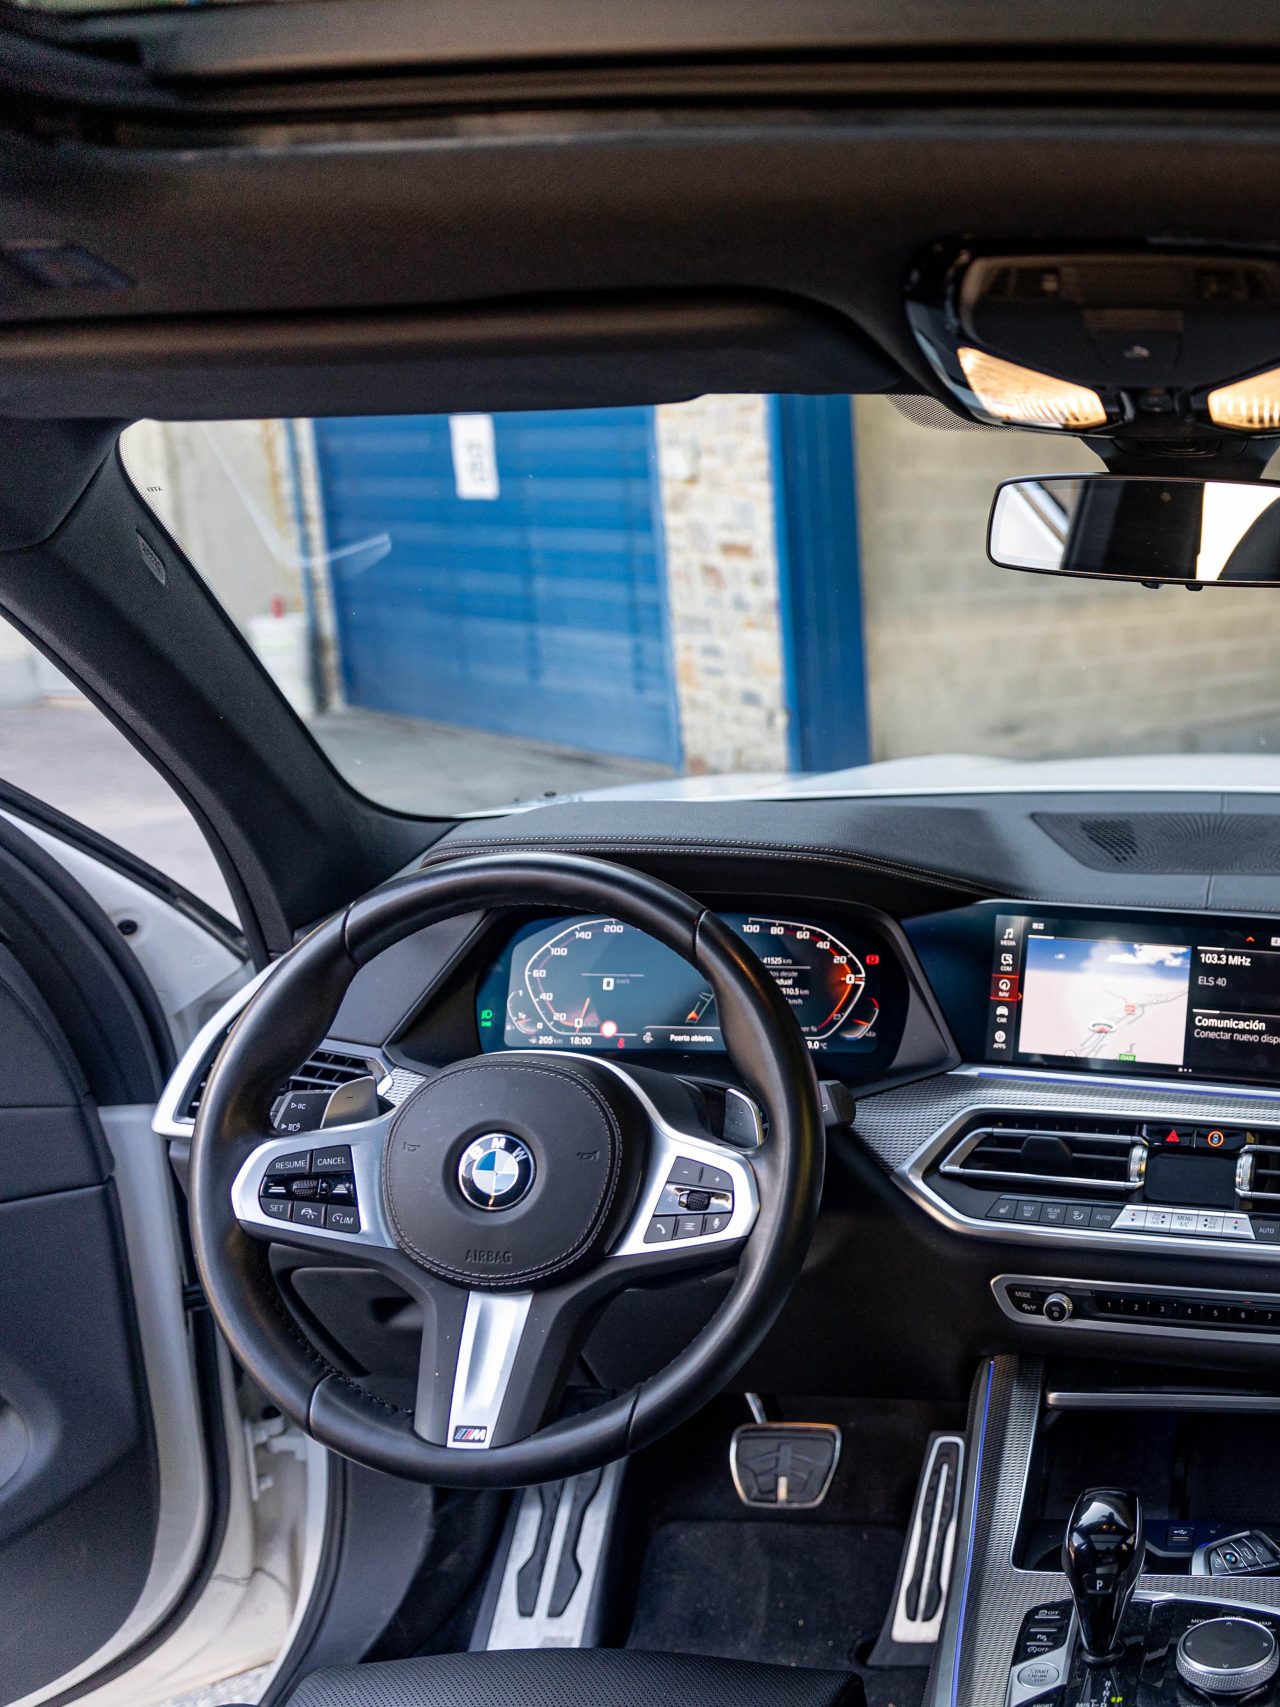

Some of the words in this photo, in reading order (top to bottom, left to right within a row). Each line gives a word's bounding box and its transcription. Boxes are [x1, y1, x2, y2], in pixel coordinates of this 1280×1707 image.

[604, 925, 624, 933] 200
[742, 924, 760, 932] 100
[770, 926, 784, 935] 80
[575, 932, 592, 940] 140
[796, 931, 810, 940] 60
[816, 941, 830, 950] 40
[834, 956, 846, 964] 20
[1200, 953, 1228, 964] 103.3
[1228, 954, 1252, 966] MHz
[532, 970, 546, 978] 60
[846, 974, 855, 984] 0
[1198, 976, 1214, 986] ELS
[1216, 977, 1227, 986] 40
[540, 992, 553, 1000] 40
[553, 1012, 566, 1020] 20
[574, 1018, 584, 1028] 0
[1194, 1016, 1266, 1031] Comunicación
[538, 1036, 553, 1044] 205
[1194, 1029, 1232, 1040] Conectar
[1234, 1034, 1260, 1042] nuevo
[570, 1036, 592, 1046] 18:00
[468, 1138, 528, 1162] BMW
[275, 1159, 306, 1170] RESUME
[317, 1156, 346, 1166] CANCEL
[270, 1204, 285, 1212] SET
[340, 1216, 354, 1224] LIM
[464, 1249, 513, 1264] AIRBAG
[1096, 1580, 1103, 1591] P
